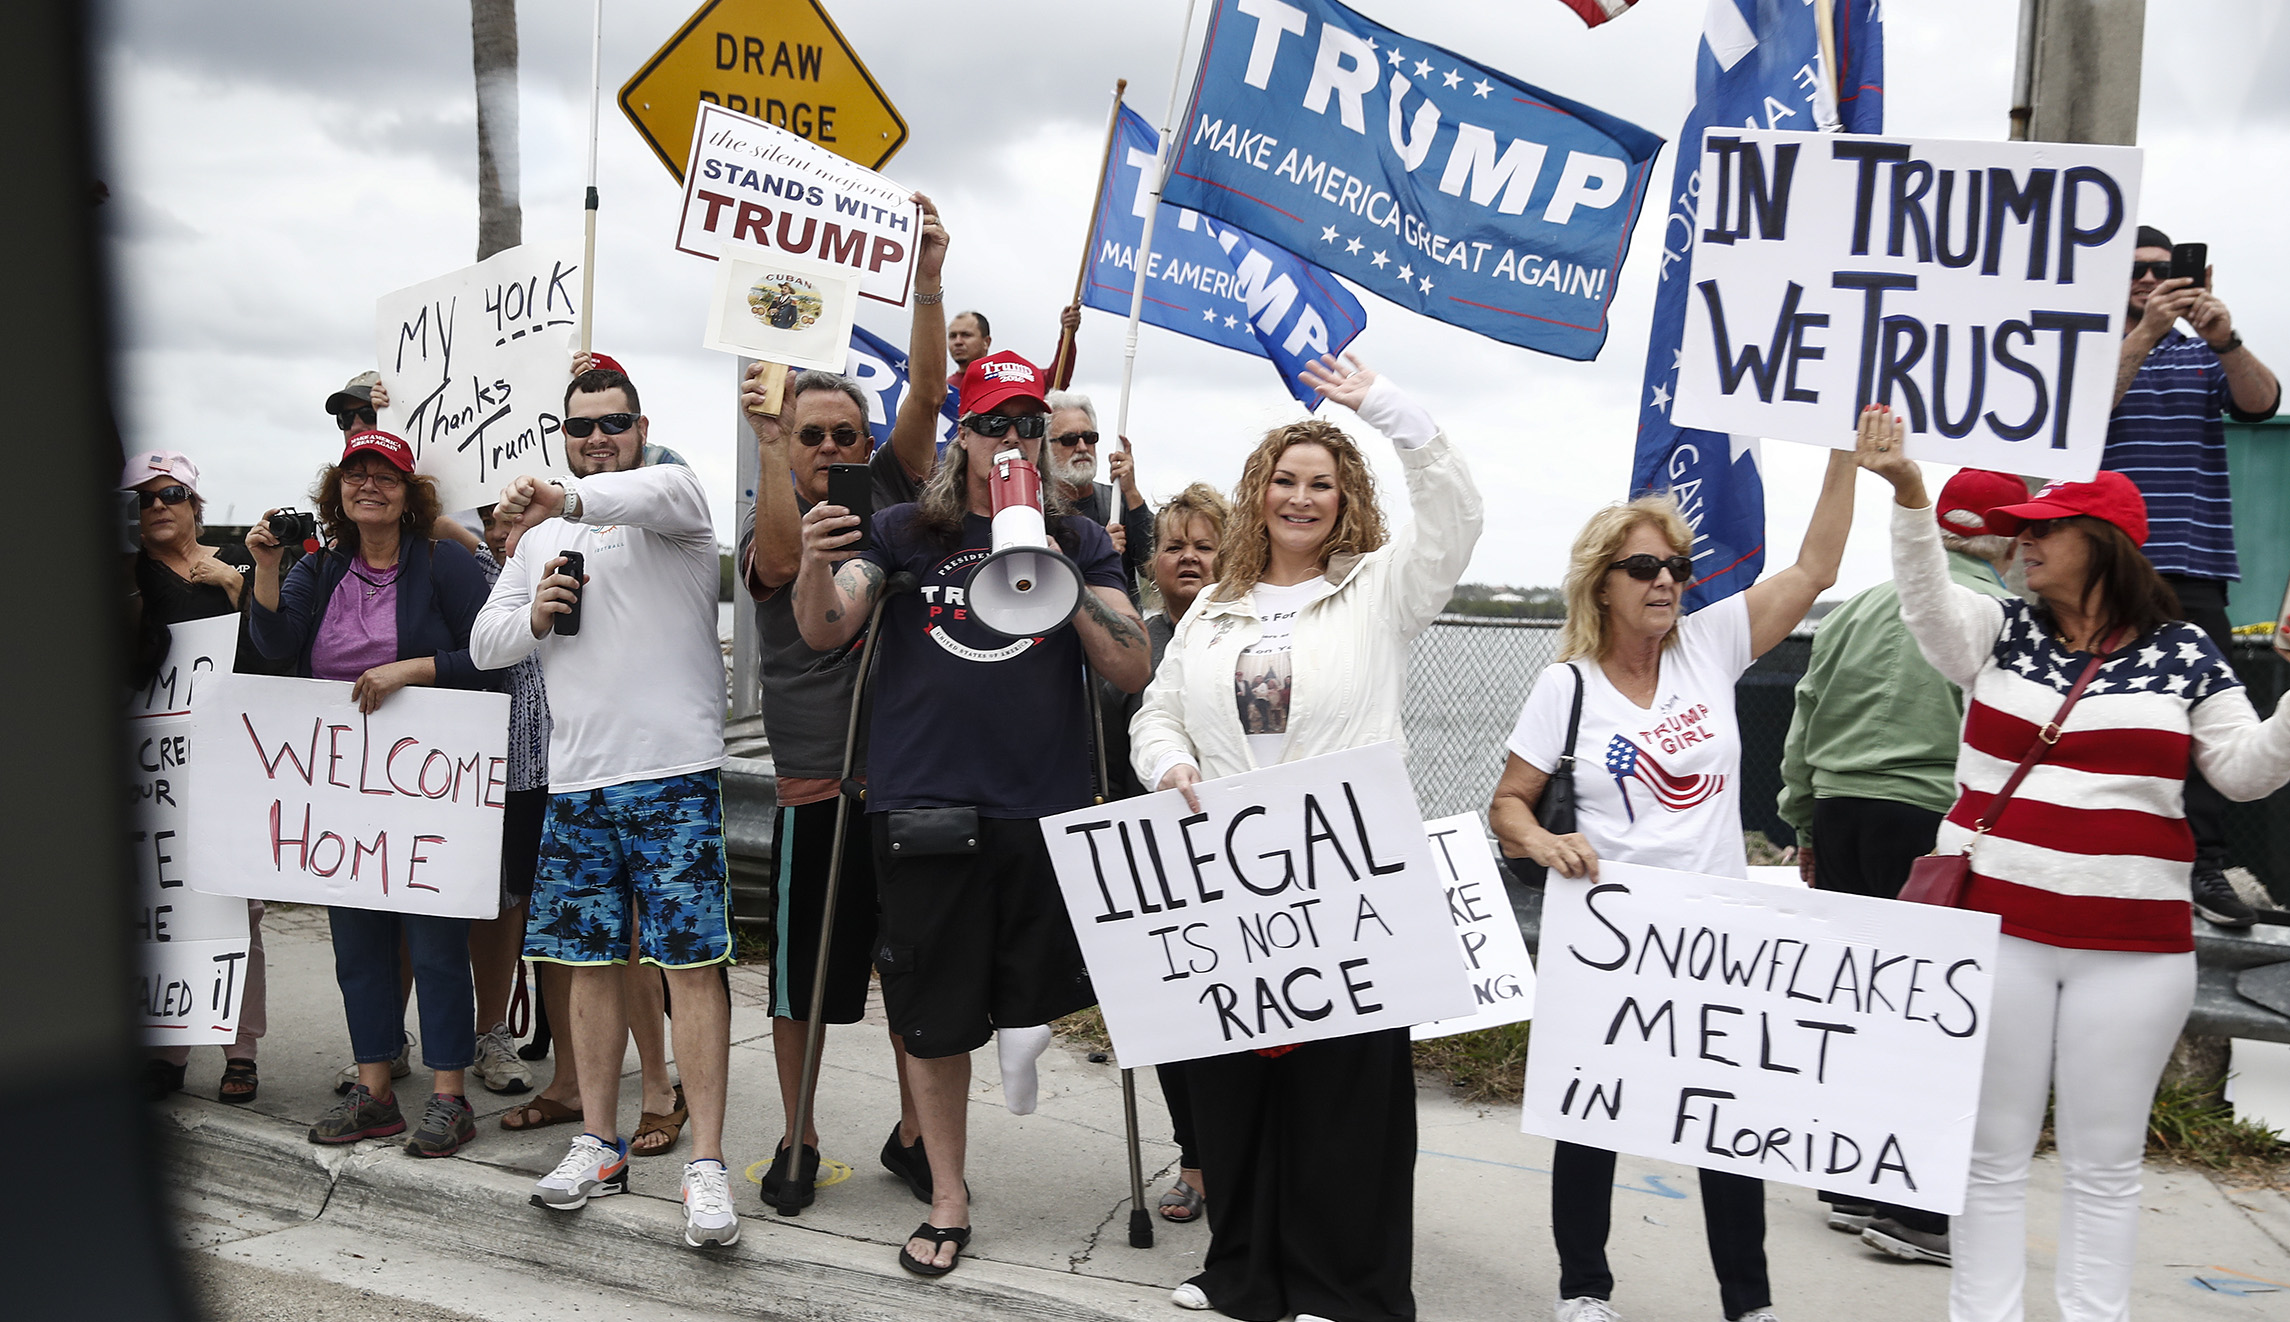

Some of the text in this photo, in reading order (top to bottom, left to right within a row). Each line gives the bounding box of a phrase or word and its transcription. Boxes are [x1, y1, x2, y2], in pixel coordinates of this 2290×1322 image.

[716, 32, 823, 83] DRAW
[1237, 0, 1628, 225] TRUMP
[703, 158, 909, 232] STANDS WITH
[709, 130, 908, 208] the silent majority
[1193, 114, 1607, 301] MAKE AMERICA GREAT AGAIN!
[1703, 136, 2124, 284] IN TRUMP
[697, 189, 905, 273] TRUMP
[396, 260, 578, 380] MY 401K
[765, 273, 813, 290] CUBAN
[1162, 258, 1248, 303] AMERIC
[981, 361, 1033, 376] Trump
[1696, 271, 2109, 449] WE TRUST
[369, 435, 402, 449] AMERICA
[375, 441, 398, 452] AGAIN
[405, 376, 512, 461] Thanks
[457, 404, 562, 484] Trump
[935, 631, 959, 651] UNITED
[960, 647, 987, 659] STATES
[1001, 640, 1029, 657] AMERICA
[138, 736, 191, 773] CRE
[241, 711, 508, 809] WELCOME
[1638, 703, 1709, 745] TRUMP
[1661, 725, 1715, 755] GIRL
[269, 799, 448, 897] HOME
[1065, 782, 1406, 924] ILLEGAL
[1148, 894, 1394, 982] IS NOT A
[1569, 883, 1982, 1038] SNOWFLAKES
[1199, 958, 1384, 1041] RACE
[1603, 996, 1858, 1084] MELT
